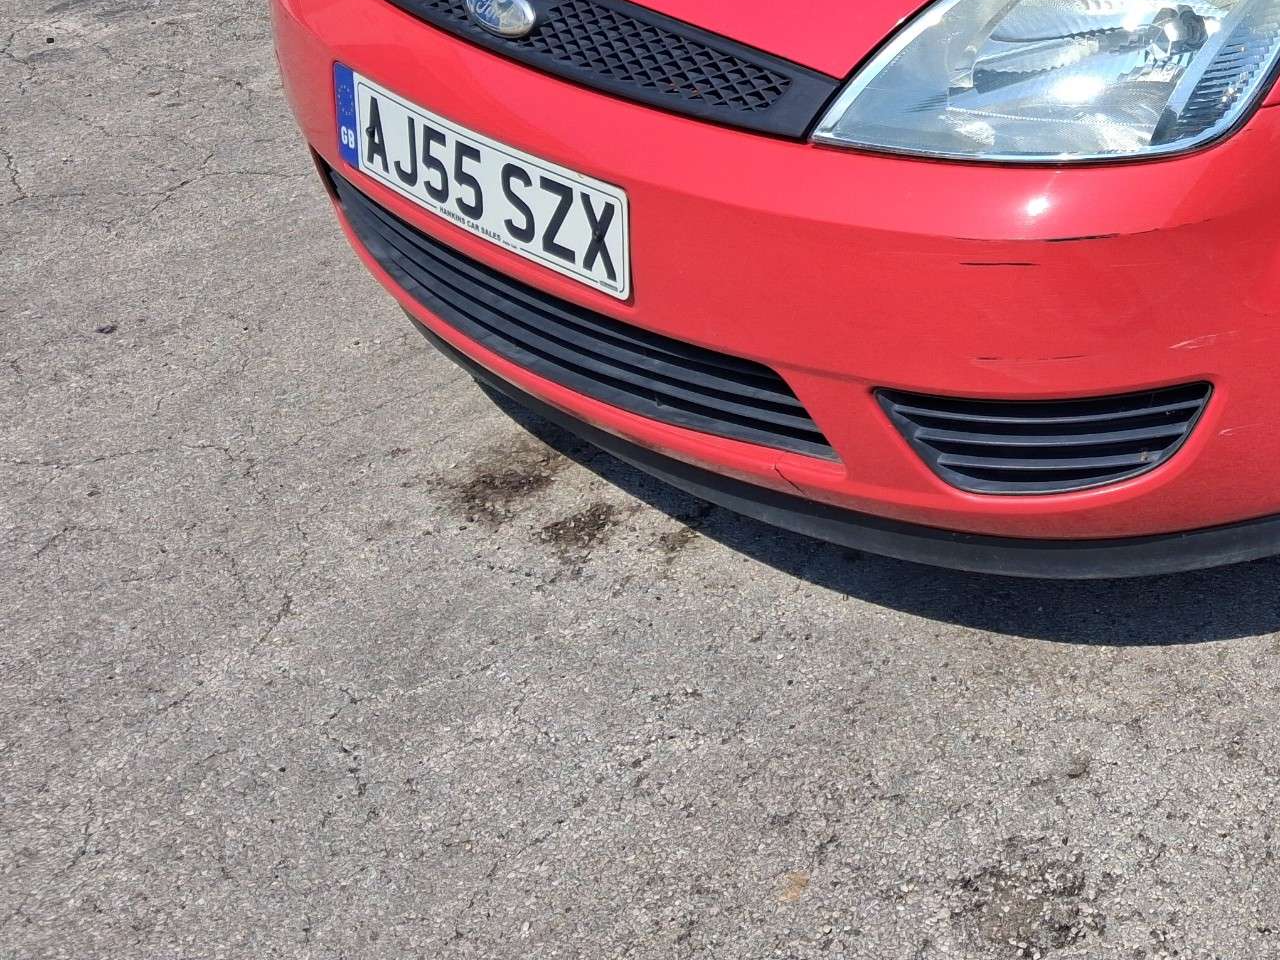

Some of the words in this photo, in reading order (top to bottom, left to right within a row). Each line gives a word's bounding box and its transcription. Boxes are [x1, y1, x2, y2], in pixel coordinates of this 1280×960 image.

[340, 125, 355, 149] GB
[366, 95, 484, 221] AJ55
[501, 162, 618, 283] SZX
[467, 220, 480, 233] CAR
[481, 227, 502, 241] SALES
